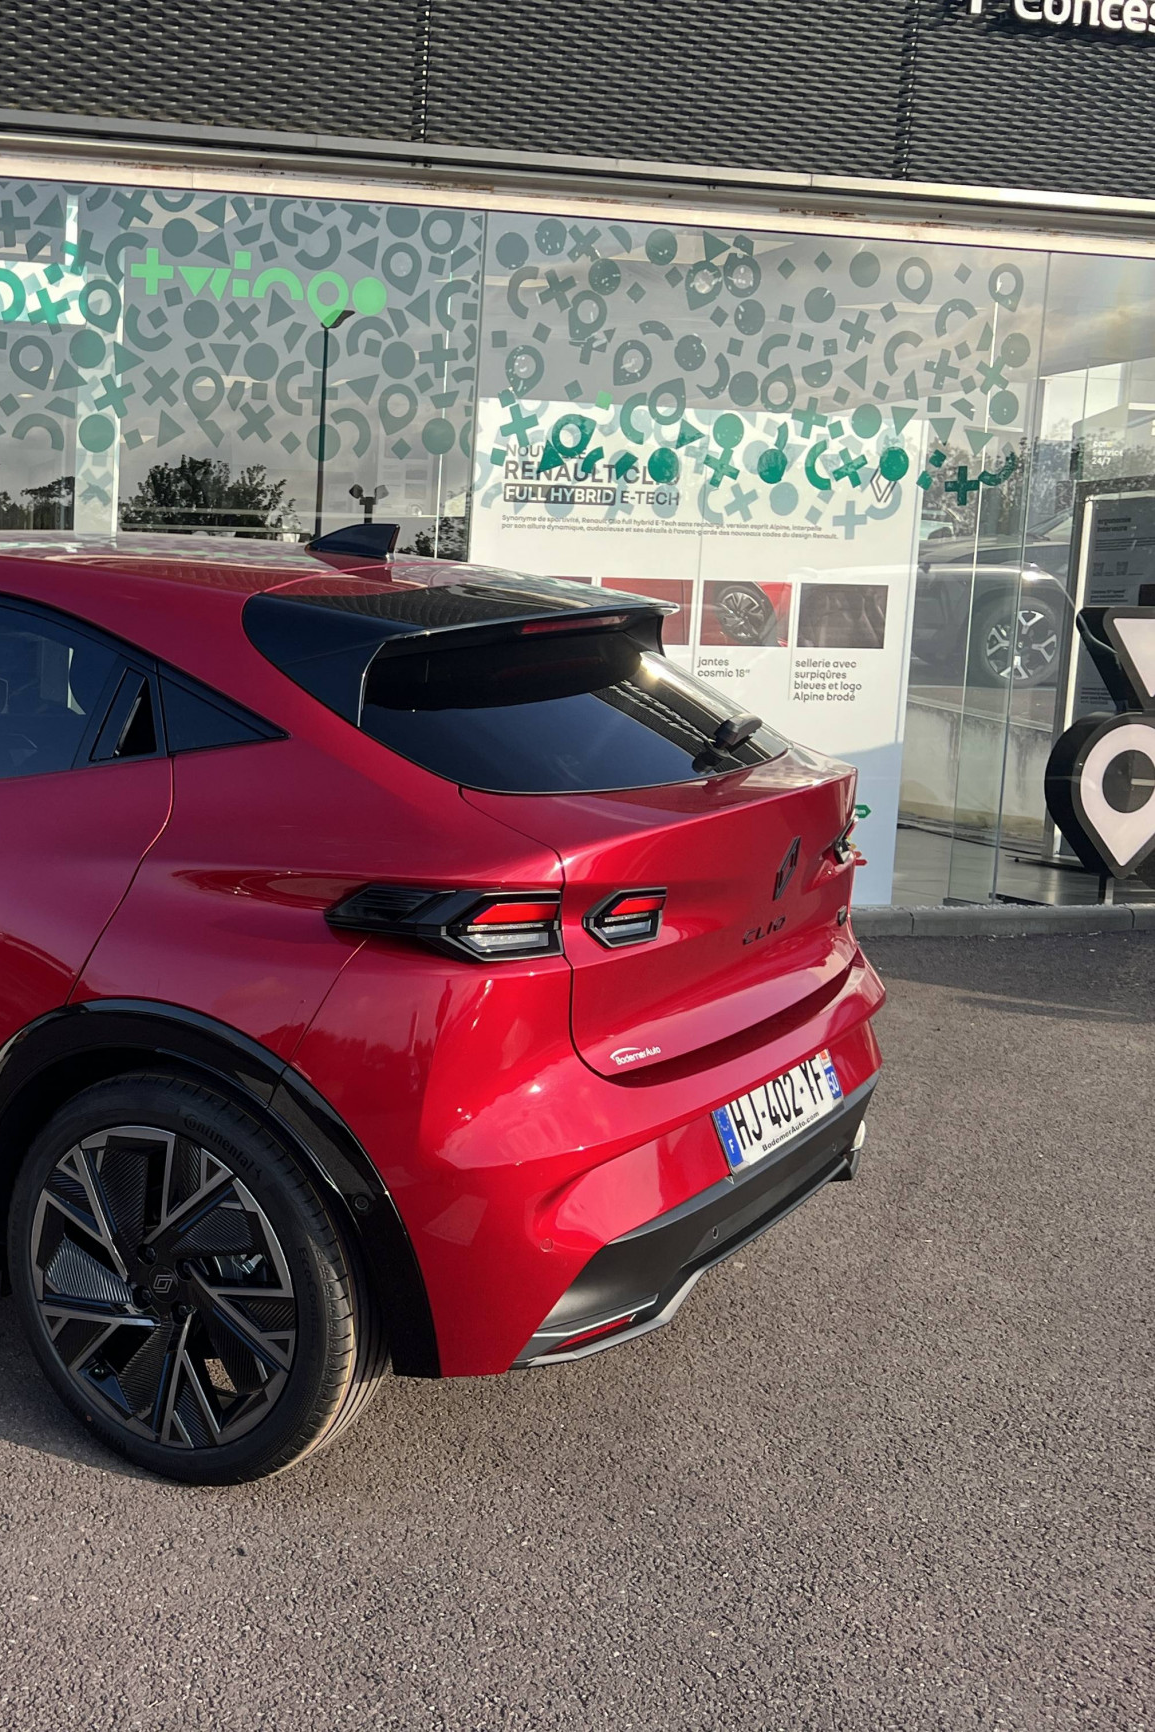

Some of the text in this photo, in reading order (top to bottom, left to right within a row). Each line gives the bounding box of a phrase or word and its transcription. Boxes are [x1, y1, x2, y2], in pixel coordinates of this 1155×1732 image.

[1091, 456, 1111, 466] 24/7
[622, 465, 681, 486] CL
[505, 486, 680, 505] FULL HYBRID E-TECH
[655, 519, 676, 527] E-Tech
[791, 532, 812, 540] design
[697, 657, 729, 667] jantes
[795, 659, 857, 669] sellerie avec
[698, 669, 734, 678] cosmic
[795, 669, 847, 681] surpiqûres
[794, 681, 862, 693] bleues et logo
[793, 690, 856, 703] Alpine brodé
[743, 916, 786, 945] CLIO
[826, 1071, 840, 1094] 50
[762, 1111, 820, 1152] BodemerAuto.com
[183, 1114, 255, 1173] Continental
[728, 1139, 735, 1154] F
